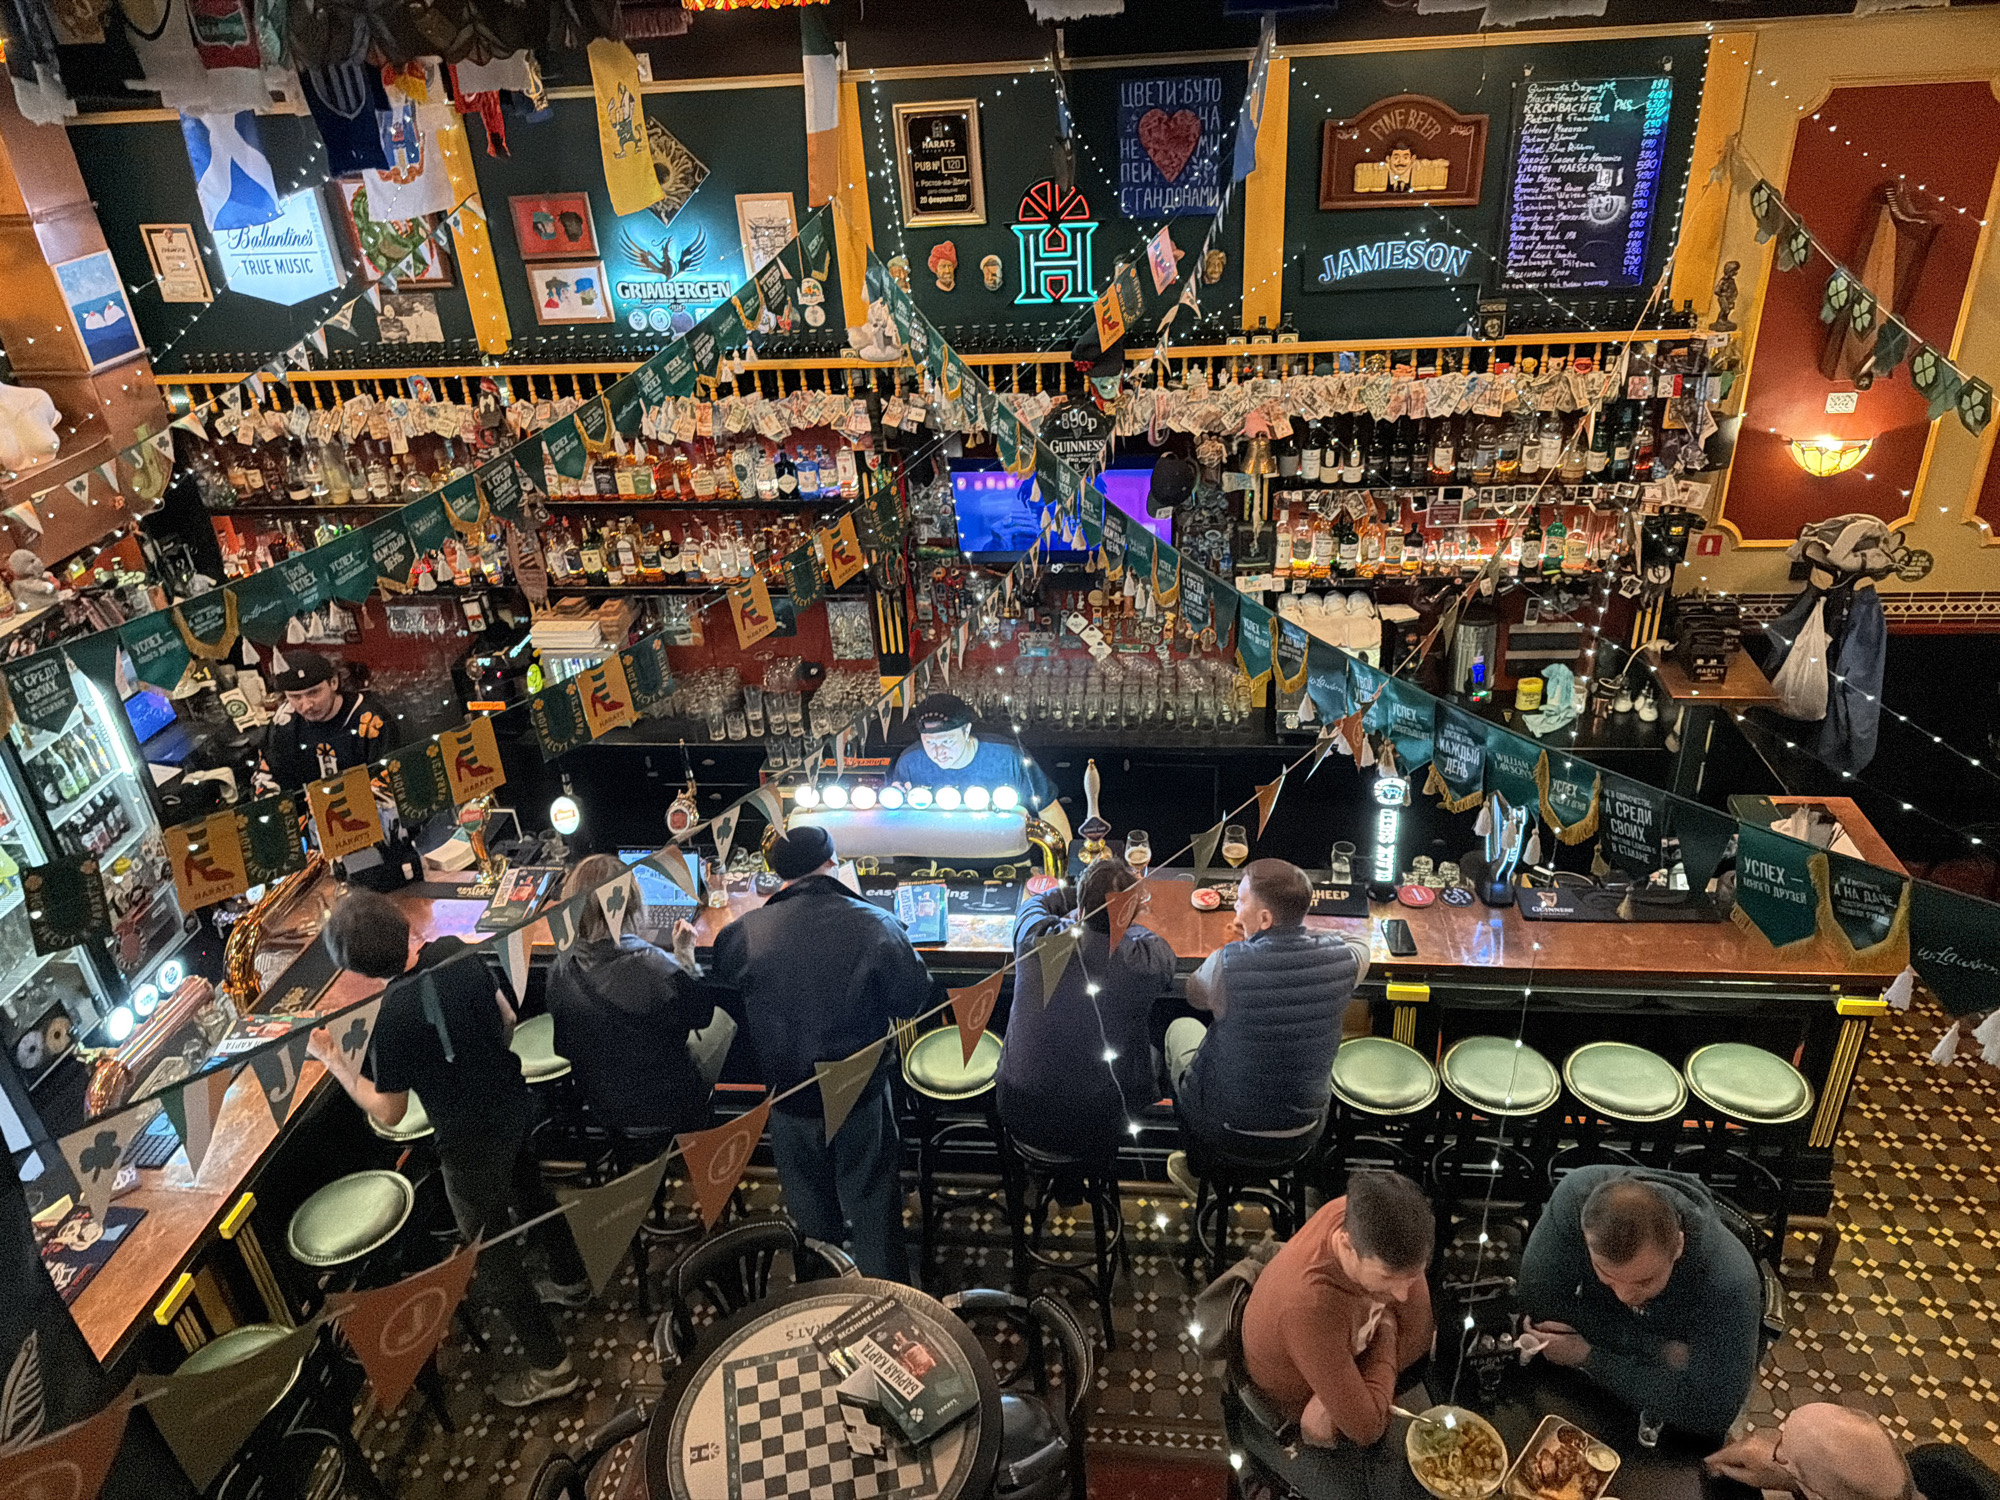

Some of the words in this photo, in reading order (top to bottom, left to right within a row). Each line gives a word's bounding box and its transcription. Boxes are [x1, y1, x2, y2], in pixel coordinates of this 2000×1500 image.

[1120, 80, 1177, 108] ЦВЕТИ
[1527, 93, 1551, 104] Black
[1198, 105, 1220, 130] НА
[1523, 102, 1602, 115] KROMBACHER
[1369, 108, 1405, 141] FINE
[1406, 108, 1442, 141] BEER
[922, 139, 956, 149] HARATS
[1120, 138, 1140, 160] НЕ
[914, 161, 931, 172] PUB
[947, 160, 961, 170] 120
[1120, 158, 1152, 183] ПЕЙ
[1135, 186, 1220, 212] ГАНДОНАМИ
[228, 224, 313, 250] Ballantine's
[241, 260, 273, 276] TRUE
[276, 258, 313, 275] MUSIC
[1318, 240, 1472, 284] JAMESON
[616, 281, 731, 300] GRIMBERGEN
[1050, 439, 1106, 454] GUINNESS
[132, 632, 164, 656] УСПЕХ
[23, 663, 60, 687] СРЕДИ
[24, 680, 59, 704] СВОИХ
[1392, 702, 1417, 722] УСПЕХ
[1439, 737, 1480, 766] КАЖДЫЙ
[1495, 752, 1530, 770] WILLIAM
[1445, 757, 1469, 779] ДЕНЬ
[1552, 778, 1578, 798] УСПЕХ
[400, 802, 428, 819] НЕСУТ
[1605, 798, 1612, 814] А
[1616, 801, 1652, 826] СРЕДИ
[334, 832, 370, 850] HARATS
[1610, 818, 1646, 843] СВОИХ
[1744, 856, 1785, 885] УСПЕХ
[1773, 886, 1807, 905] ДРУЗЕЙ
[1834, 883, 1841, 896] А
[1843, 886, 1860, 901] НА
[1863, 890, 1898, 909] ДАЧЕ,
[1532, 906, 1575, 914] GUINNESS
[558, 905, 577, 952] J
[269, 1043, 297, 1103] J
[837, 1315, 873, 1340] ВЕСЕННЕЕ
[872, 1300, 896, 1320] МЕНЮ
[860, 1341, 892, 1374] КАРТА
[884, 1363, 919, 1396] БАРНАЯ
